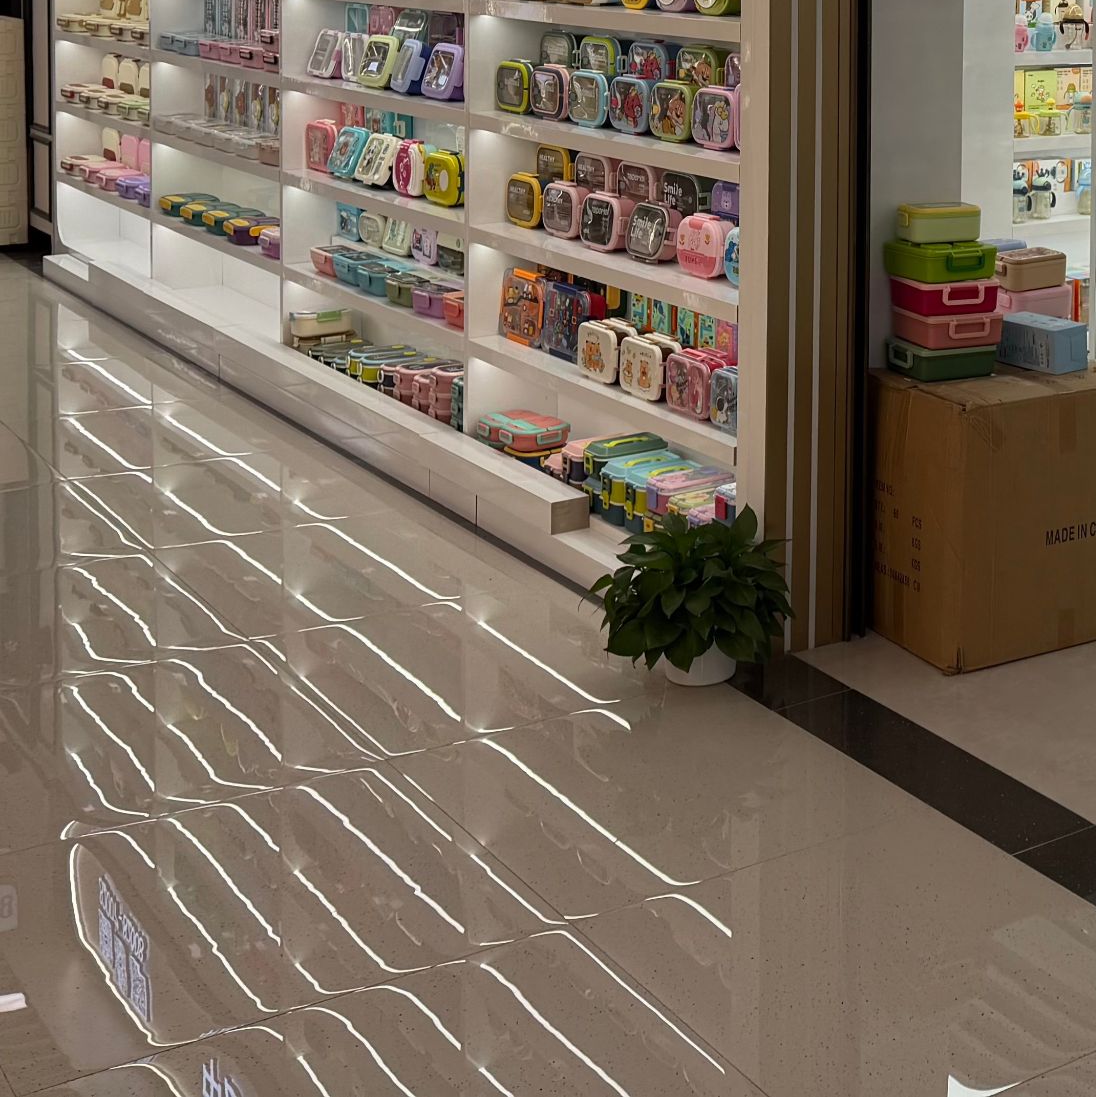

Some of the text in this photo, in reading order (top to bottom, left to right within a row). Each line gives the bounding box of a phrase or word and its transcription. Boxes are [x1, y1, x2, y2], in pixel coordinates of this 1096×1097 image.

[663, 181, 683, 197] Smile
[632, 215, 652, 230] Smile
[1045, 526, 1075, 547] MADE
[1077, 523, 1088, 540] IN
